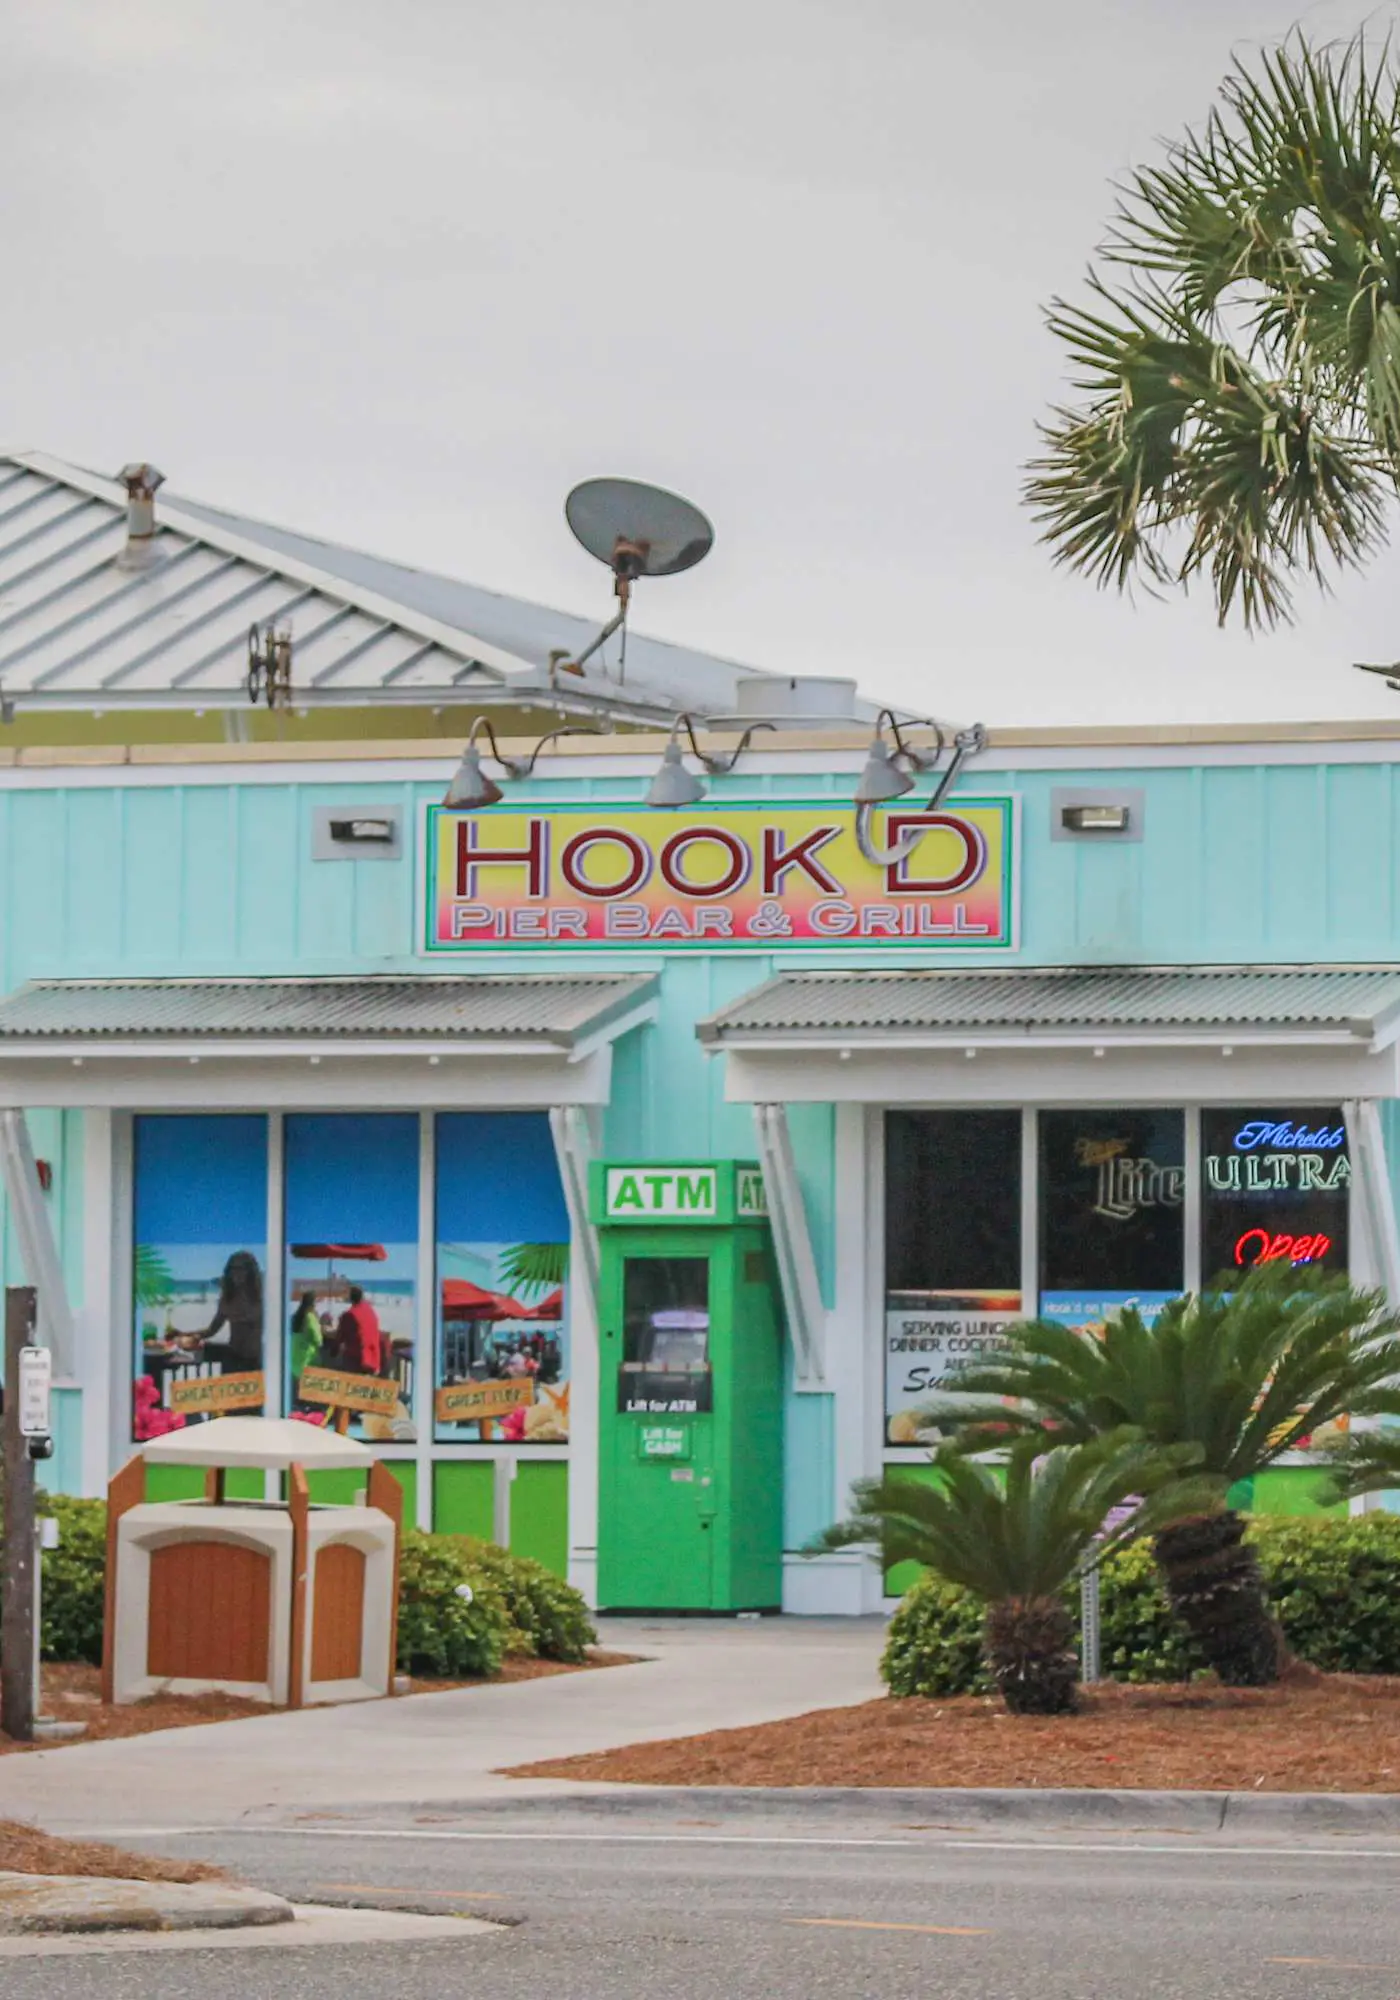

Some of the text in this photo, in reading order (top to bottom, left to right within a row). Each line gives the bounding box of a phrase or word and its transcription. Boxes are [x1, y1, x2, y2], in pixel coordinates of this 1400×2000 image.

[451, 901, 988, 938] PIER BAR & GRILL
[1234, 1120, 1345, 1150] Michelob
[1093, 1157, 1185, 1219] Lite
[1206, 1153, 1352, 1191] ULTRA
[613, 1175, 711, 1208] ATM
[741, 1175, 767, 1209] AT
[1234, 1228, 1331, 1265] Open
[902, 1320, 961, 1336] SERVING
[626, 1399, 697, 1412] Lift for ATM
